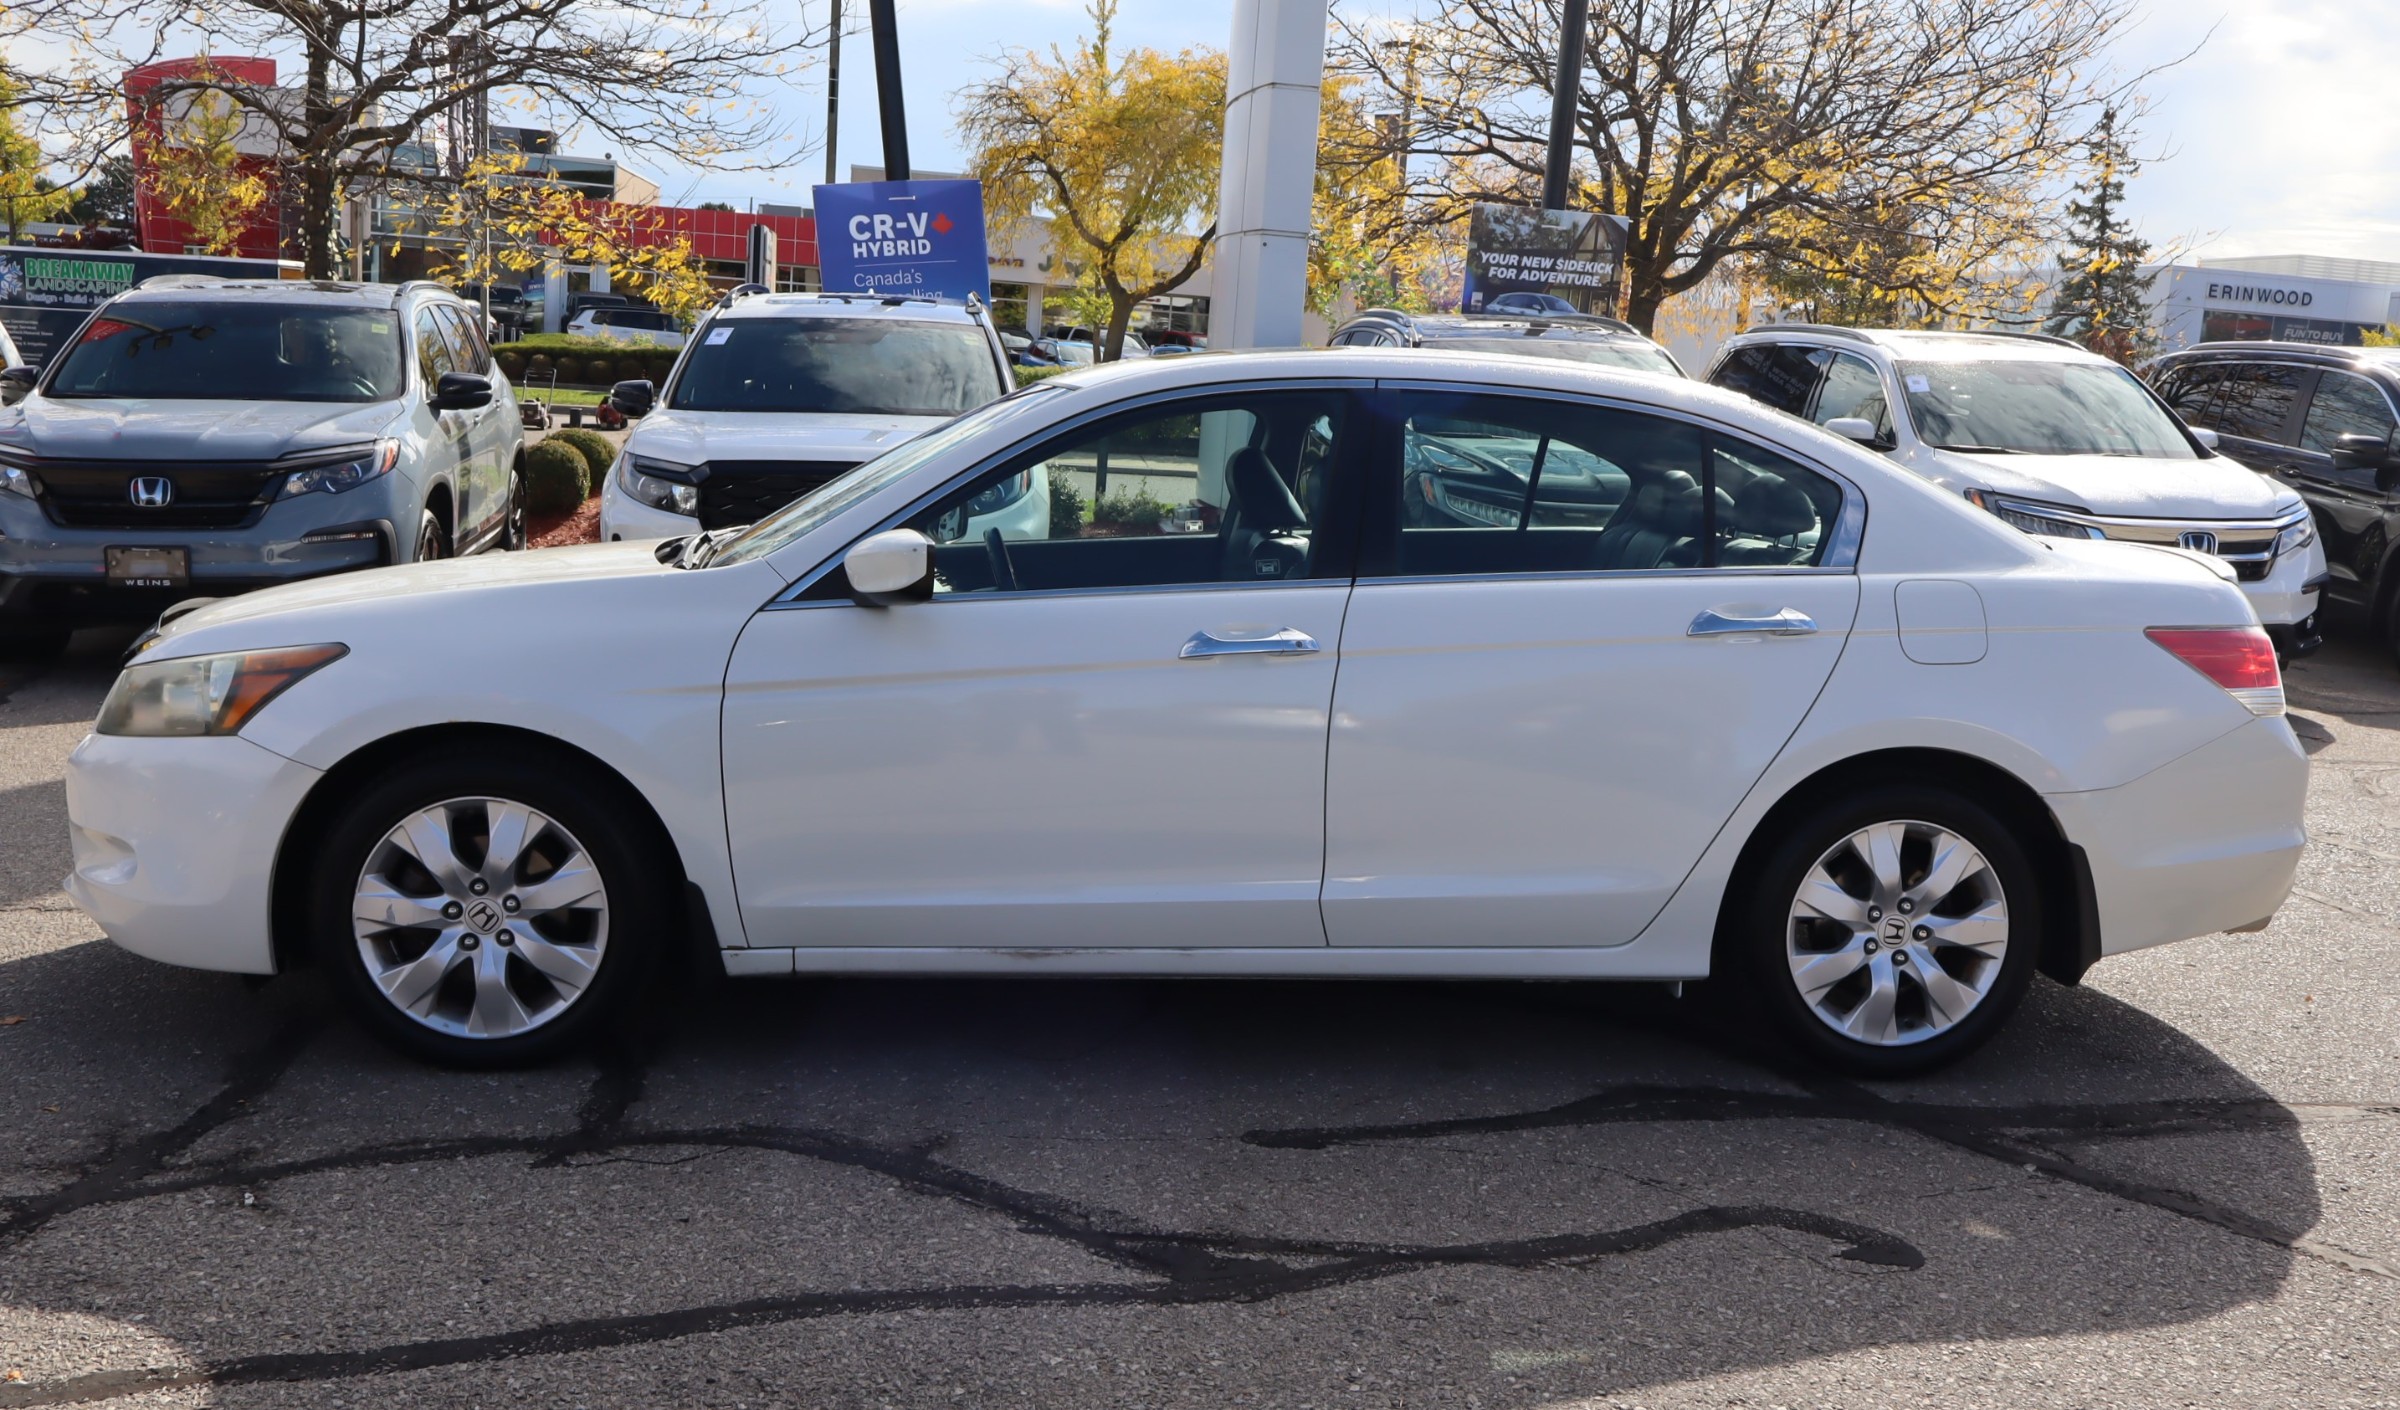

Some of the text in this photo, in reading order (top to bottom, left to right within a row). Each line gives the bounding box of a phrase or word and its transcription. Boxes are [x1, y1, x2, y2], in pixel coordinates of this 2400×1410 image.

[849, 212, 928, 241] CR-V
[852, 239, 931, 259] HYBRID
[24, 257, 135, 283] BREAKAWAY
[1480, 251, 1615, 275] YOUR NEW SIDEKICK
[25, 277, 133, 295] LANDSCAPING
[853, 268, 923, 288] Canada's
[1488, 266, 1603, 288] FOR ADVENTURE.
[2208, 283, 2313, 307] ERINWOOD
[2284, 328, 2306, 339] FUN
[2307, 330, 2321, 340] TO
